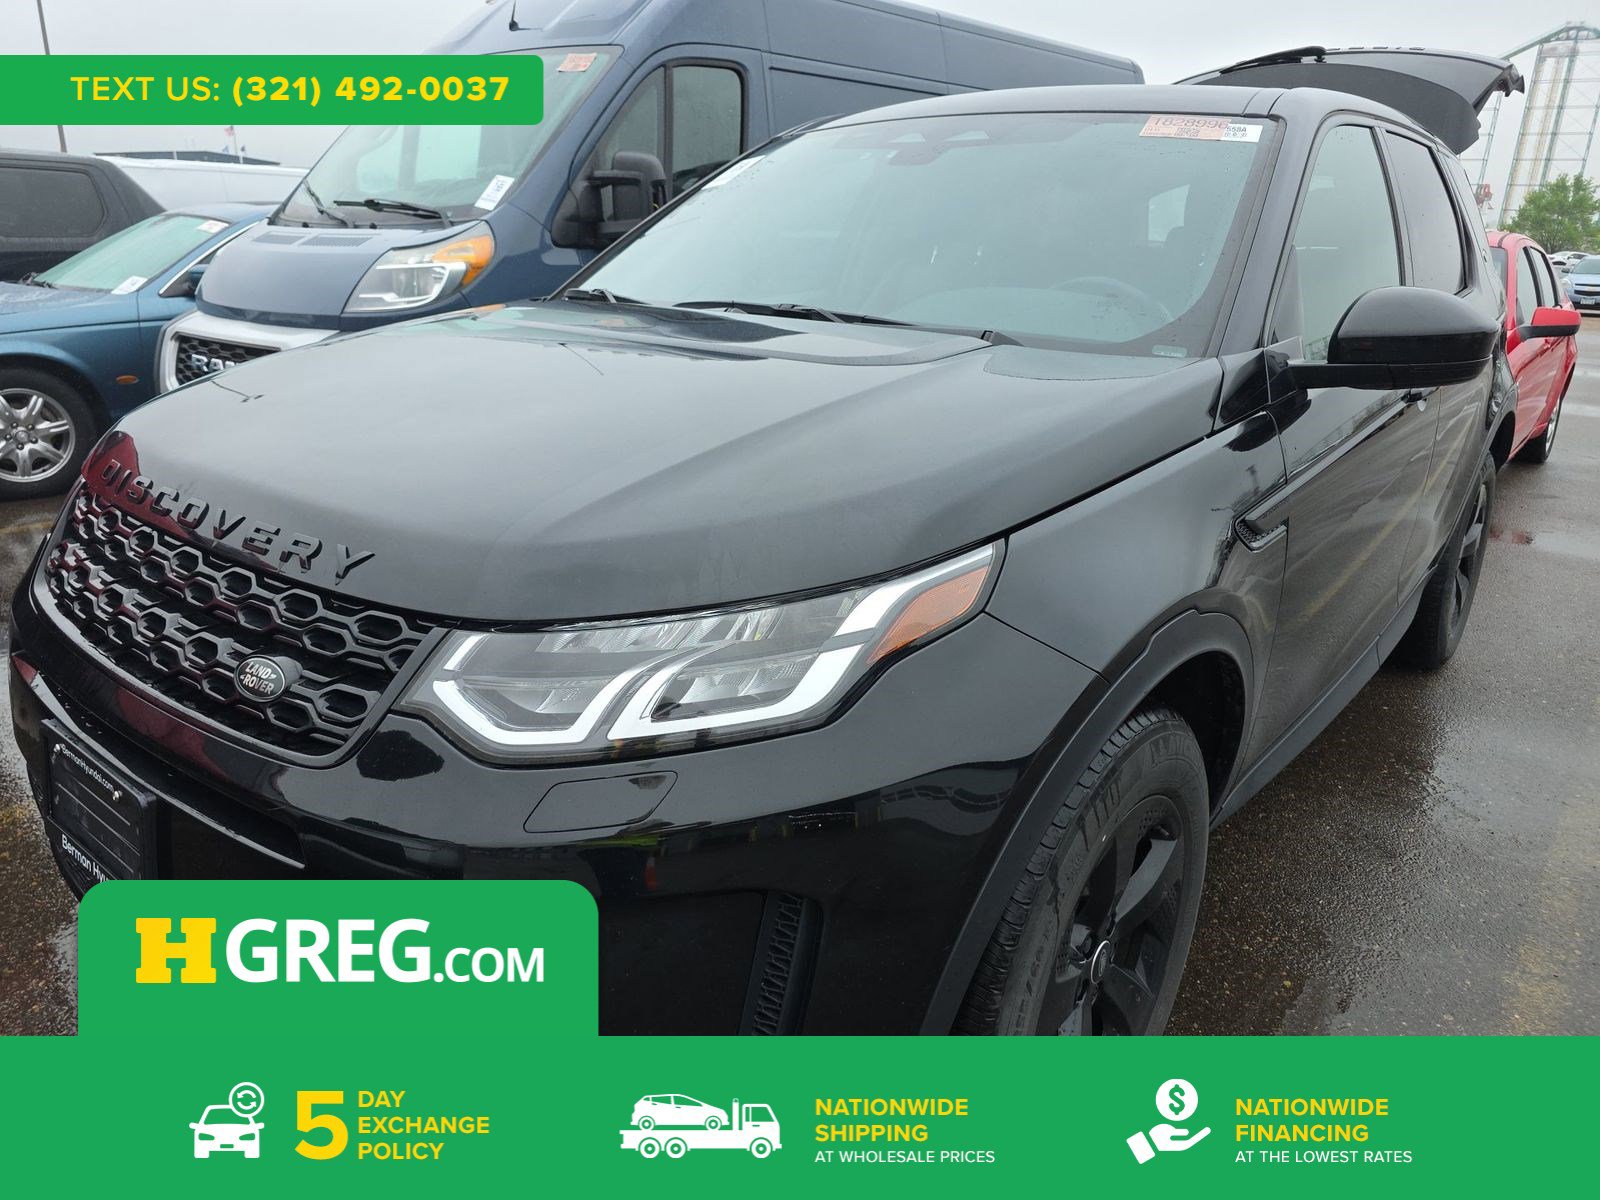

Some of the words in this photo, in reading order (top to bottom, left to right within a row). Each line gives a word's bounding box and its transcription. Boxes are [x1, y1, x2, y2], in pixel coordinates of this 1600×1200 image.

[101, 458, 376, 580] DISCOVERY
[243, 673, 275, 695] ROVER
[245, 661, 273, 680] LAND
[61, 833, 92, 873] Berman
